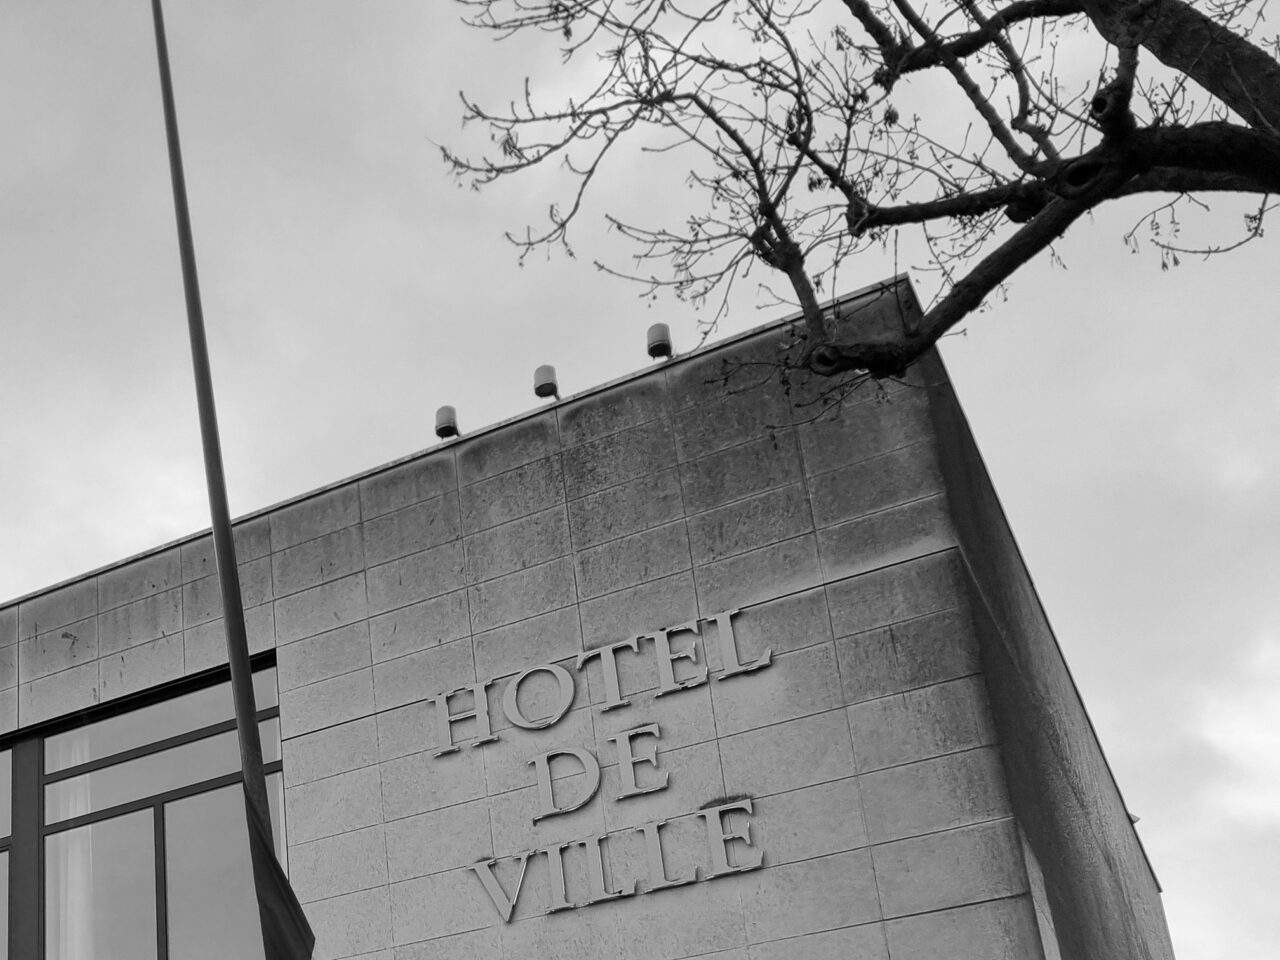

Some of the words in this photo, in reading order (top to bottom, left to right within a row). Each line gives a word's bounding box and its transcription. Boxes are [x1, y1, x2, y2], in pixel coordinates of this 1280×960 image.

[426, 609, 772, 758] HOTEL
[528, 723, 670, 825] DE
[469, 797, 764, 923] VILLE
